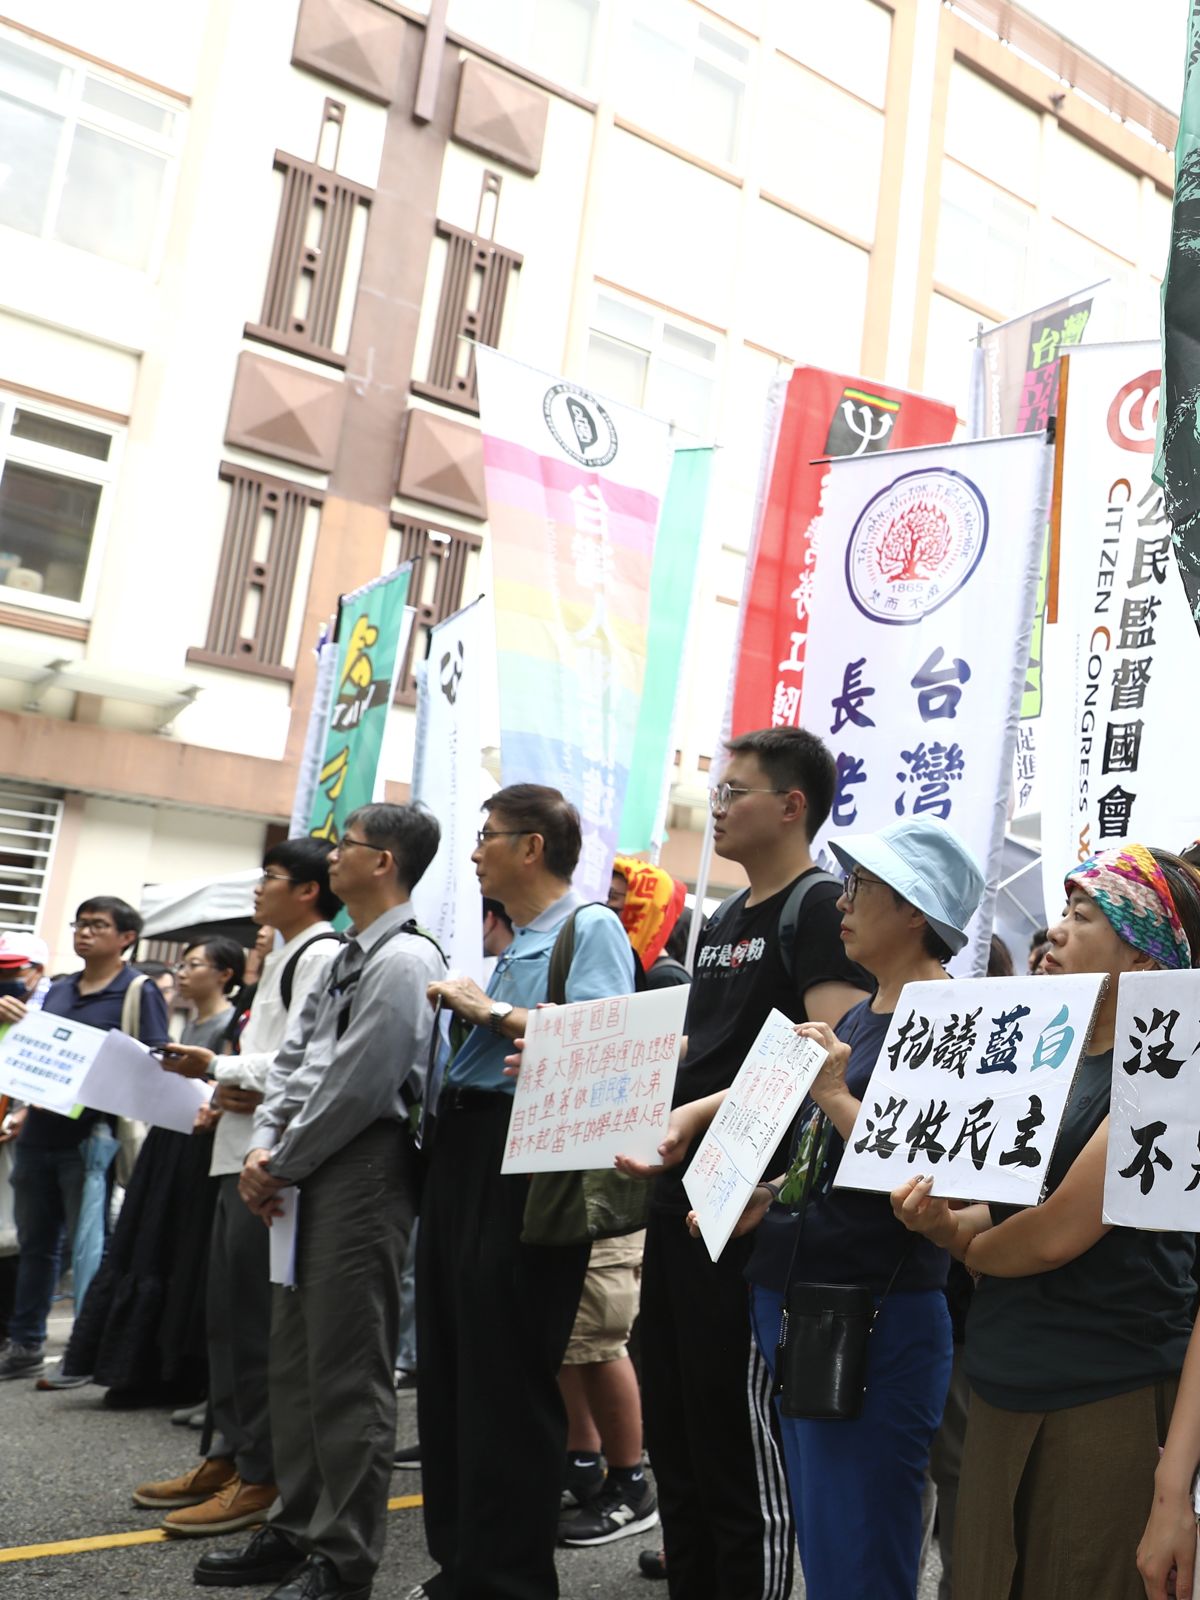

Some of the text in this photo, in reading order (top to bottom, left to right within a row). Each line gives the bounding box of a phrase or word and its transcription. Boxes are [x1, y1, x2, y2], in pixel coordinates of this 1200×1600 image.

[891, 583, 924, 594] 1865
[1095, 477, 1132, 614] CITIZEN
[1077, 625, 1112, 813] CONGRESS
[1098, 480, 1172, 839] 公民監督國會
[895, 646, 972, 820] 台灣
[887, 1004, 1075, 1079] 抗議藍白
[854, 1094, 1047, 1170] 沒收民主
